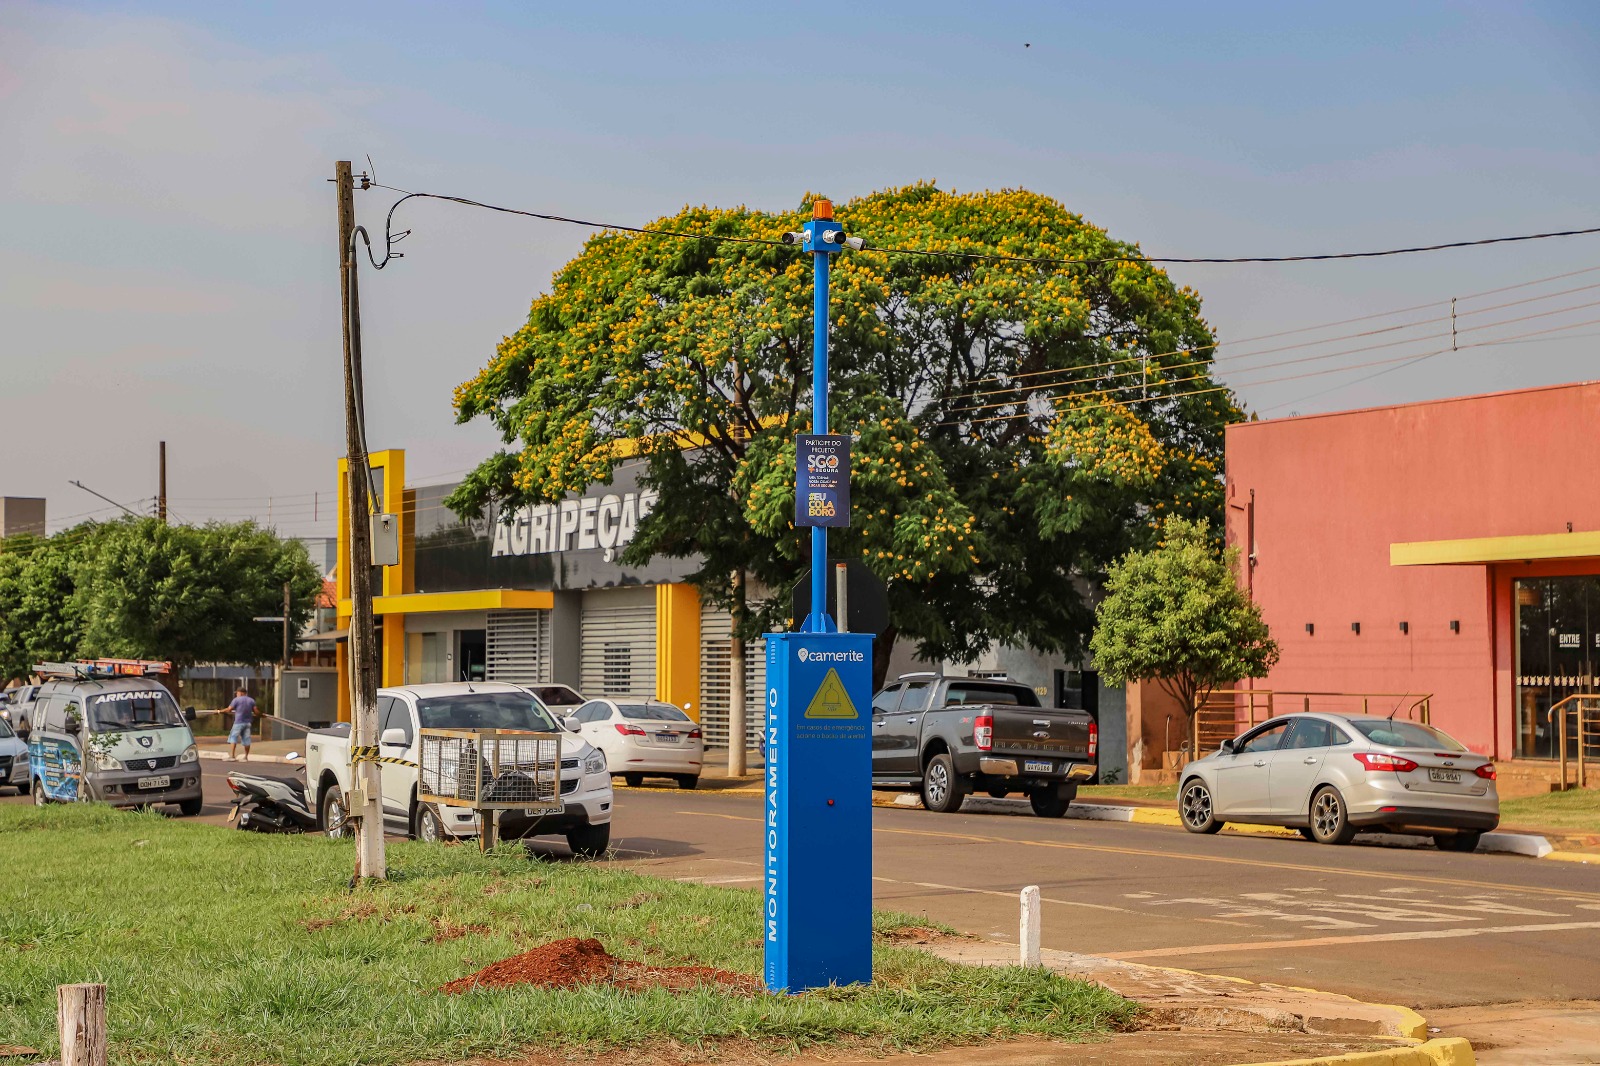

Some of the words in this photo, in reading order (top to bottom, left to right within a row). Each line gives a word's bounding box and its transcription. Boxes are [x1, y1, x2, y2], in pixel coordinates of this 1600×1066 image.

[808, 454, 839, 469] SGO
[809, 500, 834, 509] COLA
[809, 508, 836, 517] BORO
[1559, 633, 1580, 644] ENTRE
[808, 650, 864, 662] camerite
[95, 691, 162, 705] ARKANJO
[769, 688, 778, 942] MONITORAMENTO
